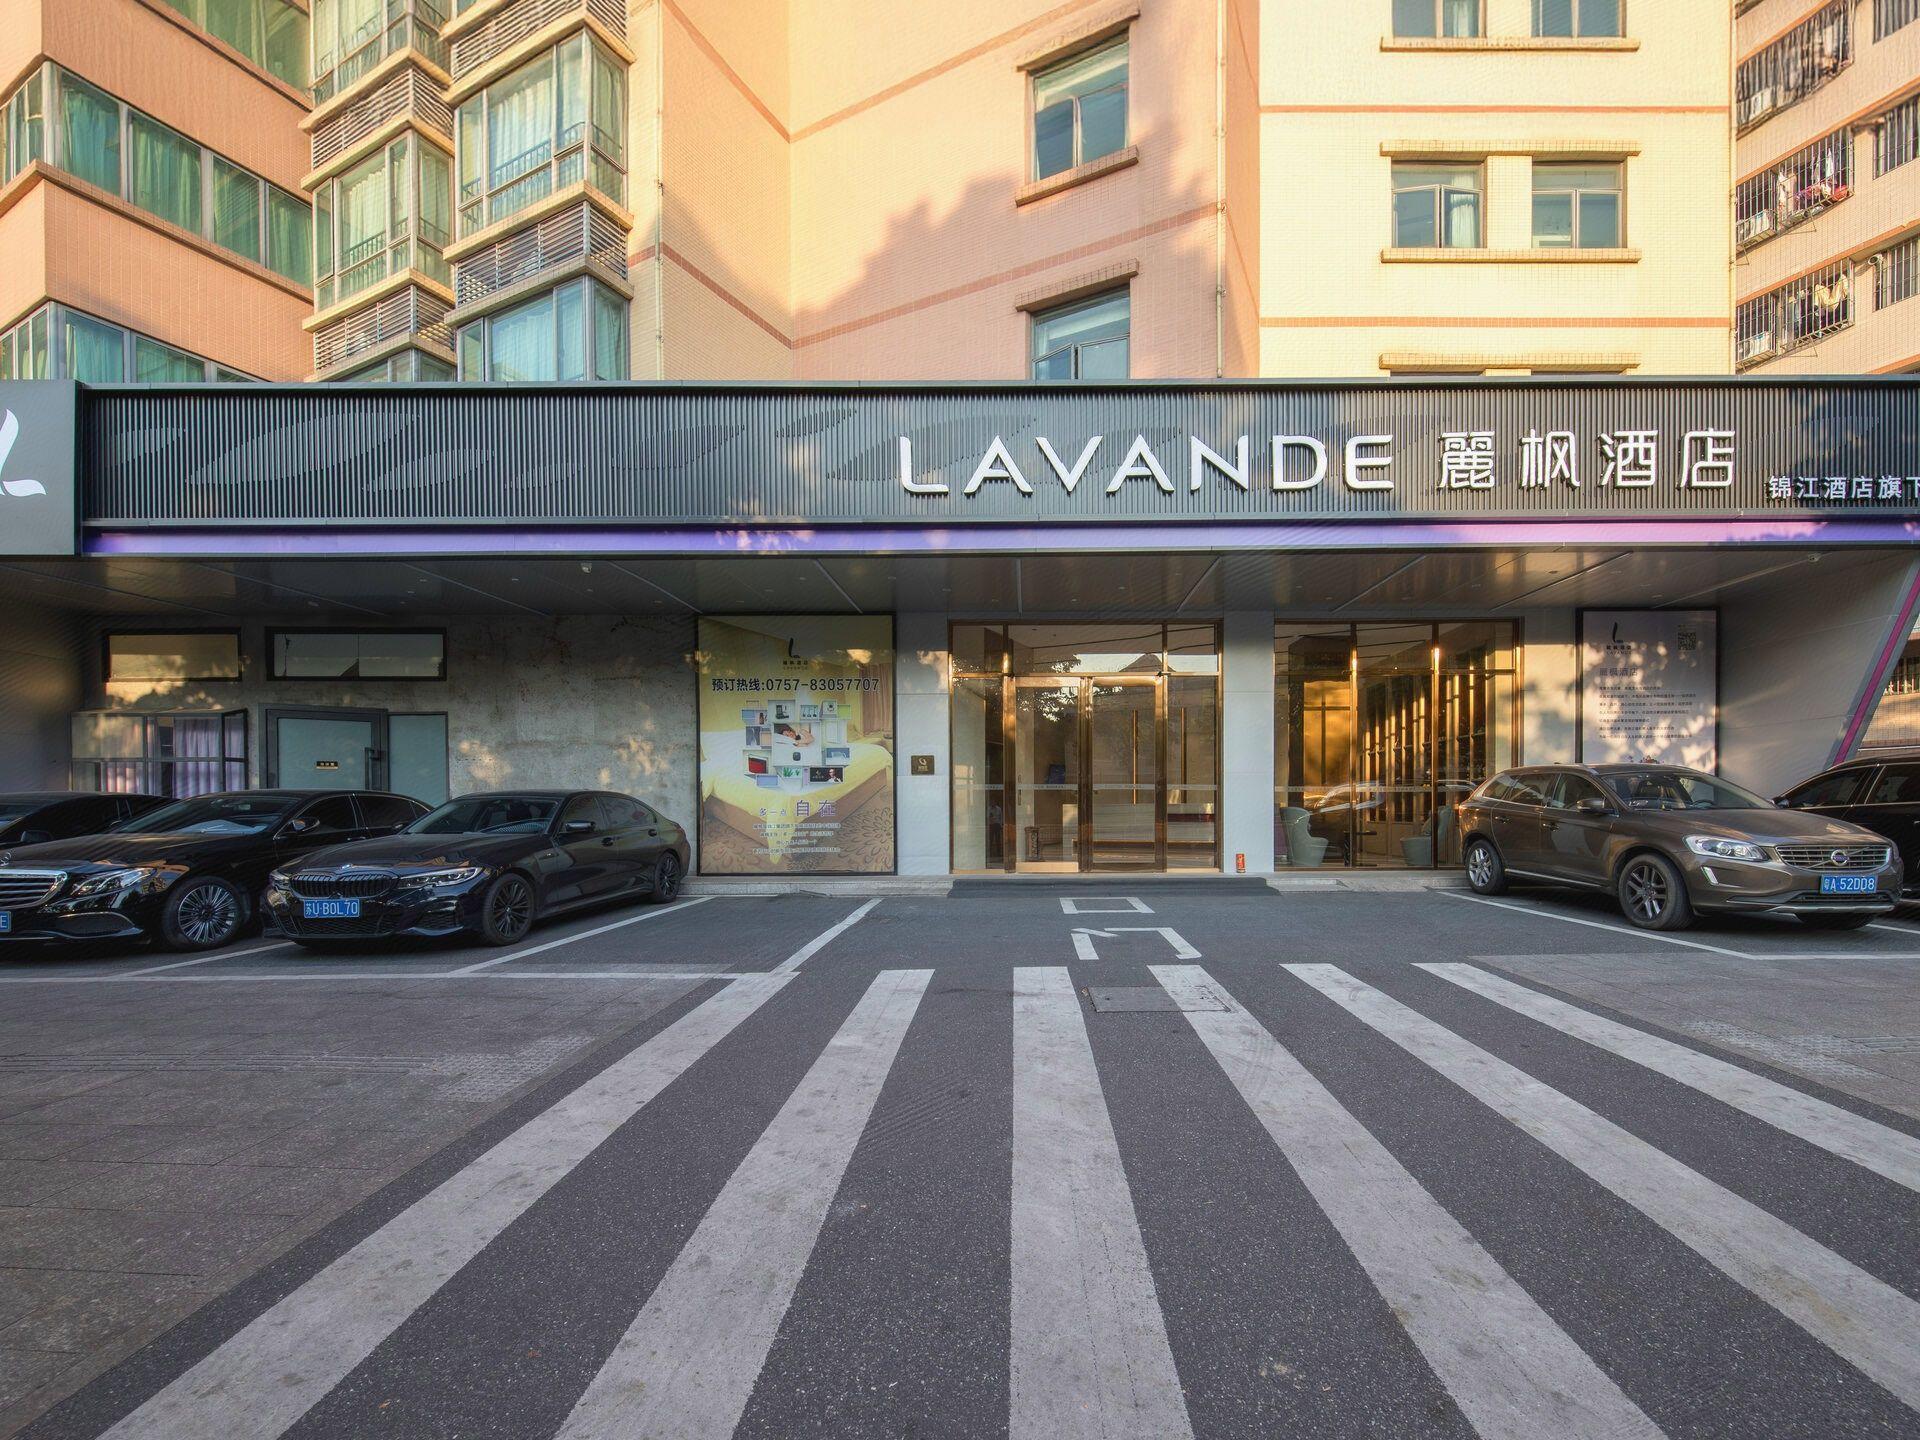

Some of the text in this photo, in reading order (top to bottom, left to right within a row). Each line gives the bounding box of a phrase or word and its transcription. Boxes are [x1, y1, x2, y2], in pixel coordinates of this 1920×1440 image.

[899, 429, 1737, 494] LAVANDE 麗枫酒店
